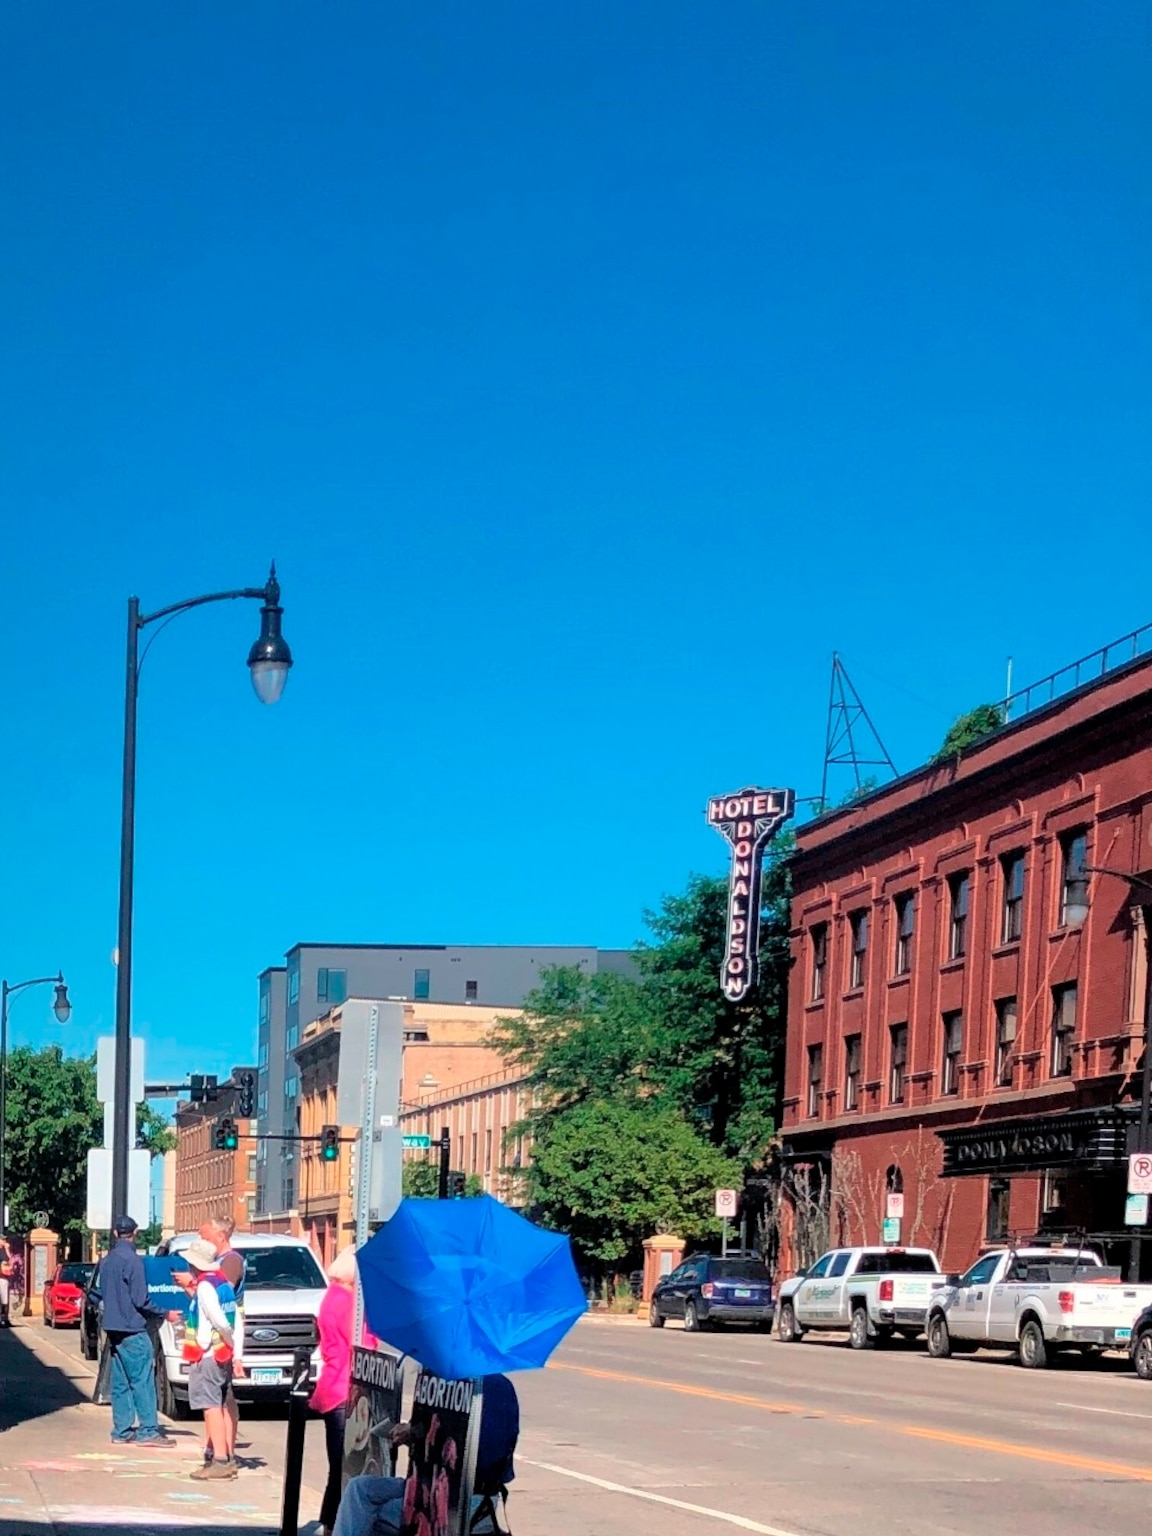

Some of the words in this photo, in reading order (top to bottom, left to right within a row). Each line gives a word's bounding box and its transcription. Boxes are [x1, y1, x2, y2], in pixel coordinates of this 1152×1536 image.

[710, 794, 781, 820] HOTEL
[727, 821, 753, 993] DONALDSON
[415, 1374, 474, 1414] ABORTION
